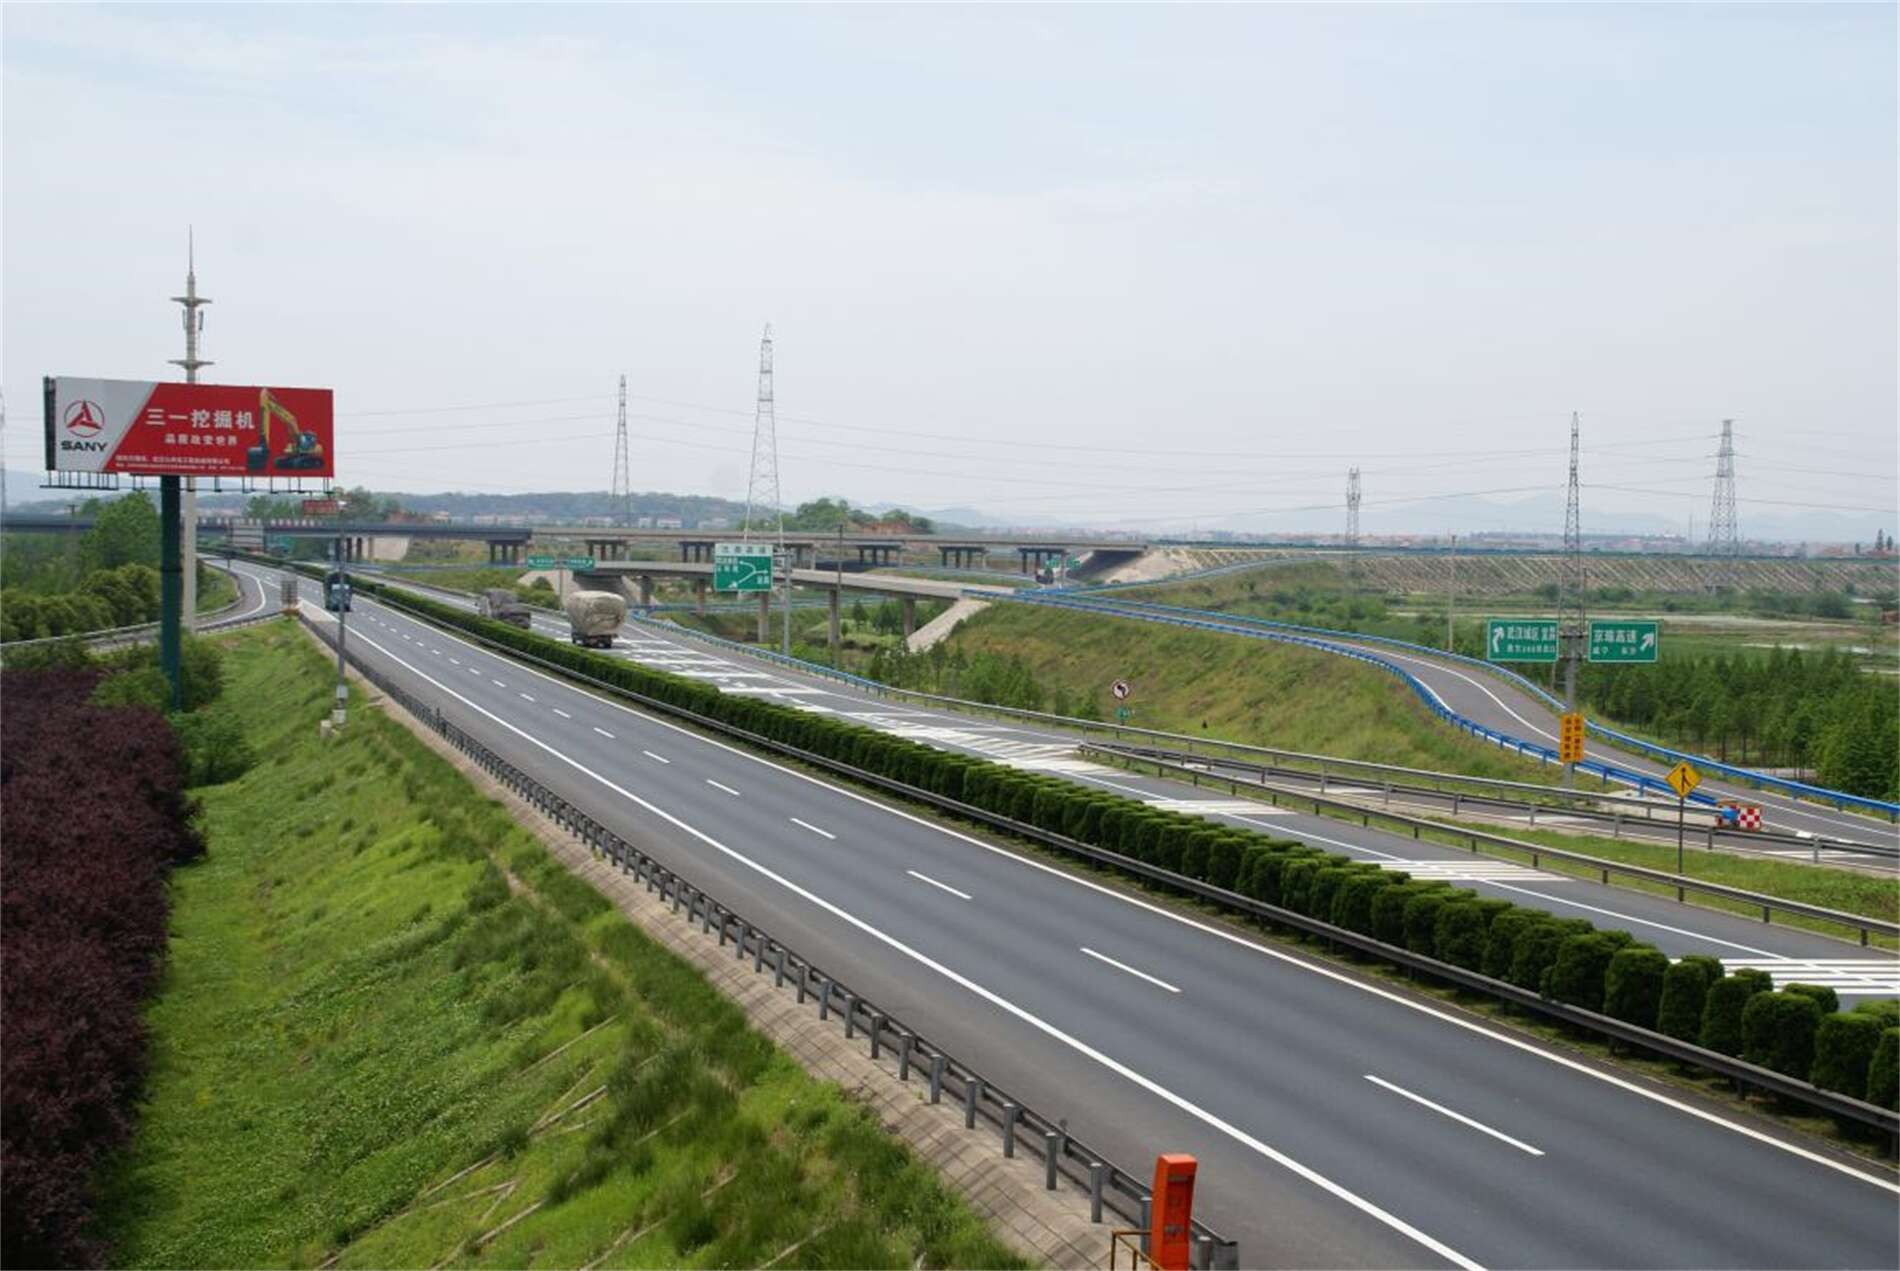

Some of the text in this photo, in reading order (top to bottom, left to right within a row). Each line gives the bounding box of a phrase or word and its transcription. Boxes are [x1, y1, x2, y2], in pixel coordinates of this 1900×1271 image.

[145, 408, 255, 430] 三一挖掘机
[61, 440, 107, 452] SANY
